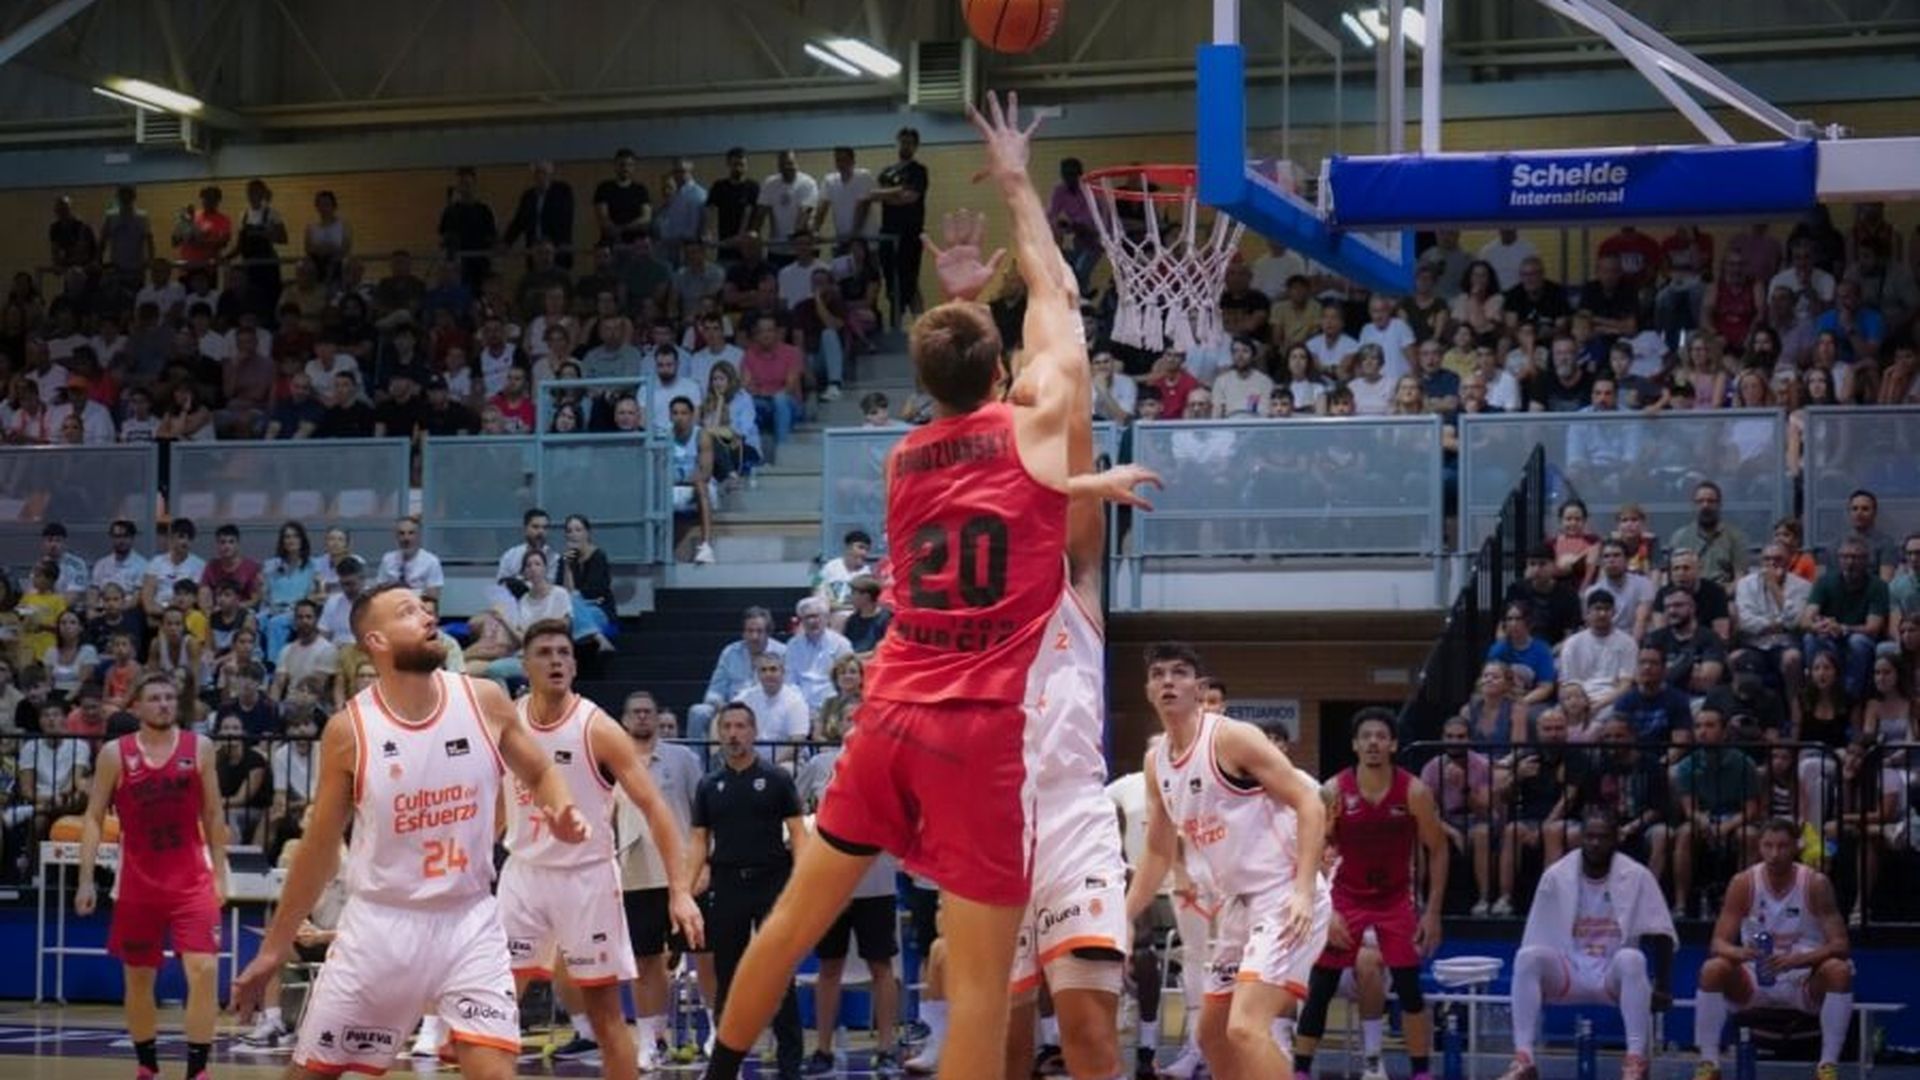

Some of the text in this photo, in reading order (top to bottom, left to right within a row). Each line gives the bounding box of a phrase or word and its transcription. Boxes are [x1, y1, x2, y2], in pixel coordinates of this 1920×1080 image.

[1511, 162, 1628, 187] Schelde
[1509, 187, 1625, 205] International
[909, 514, 1007, 608] 20
[394, 784, 463, 814] Cultura
[423, 837, 469, 879] 24
[345, 1030, 392, 1045] PULEVA
